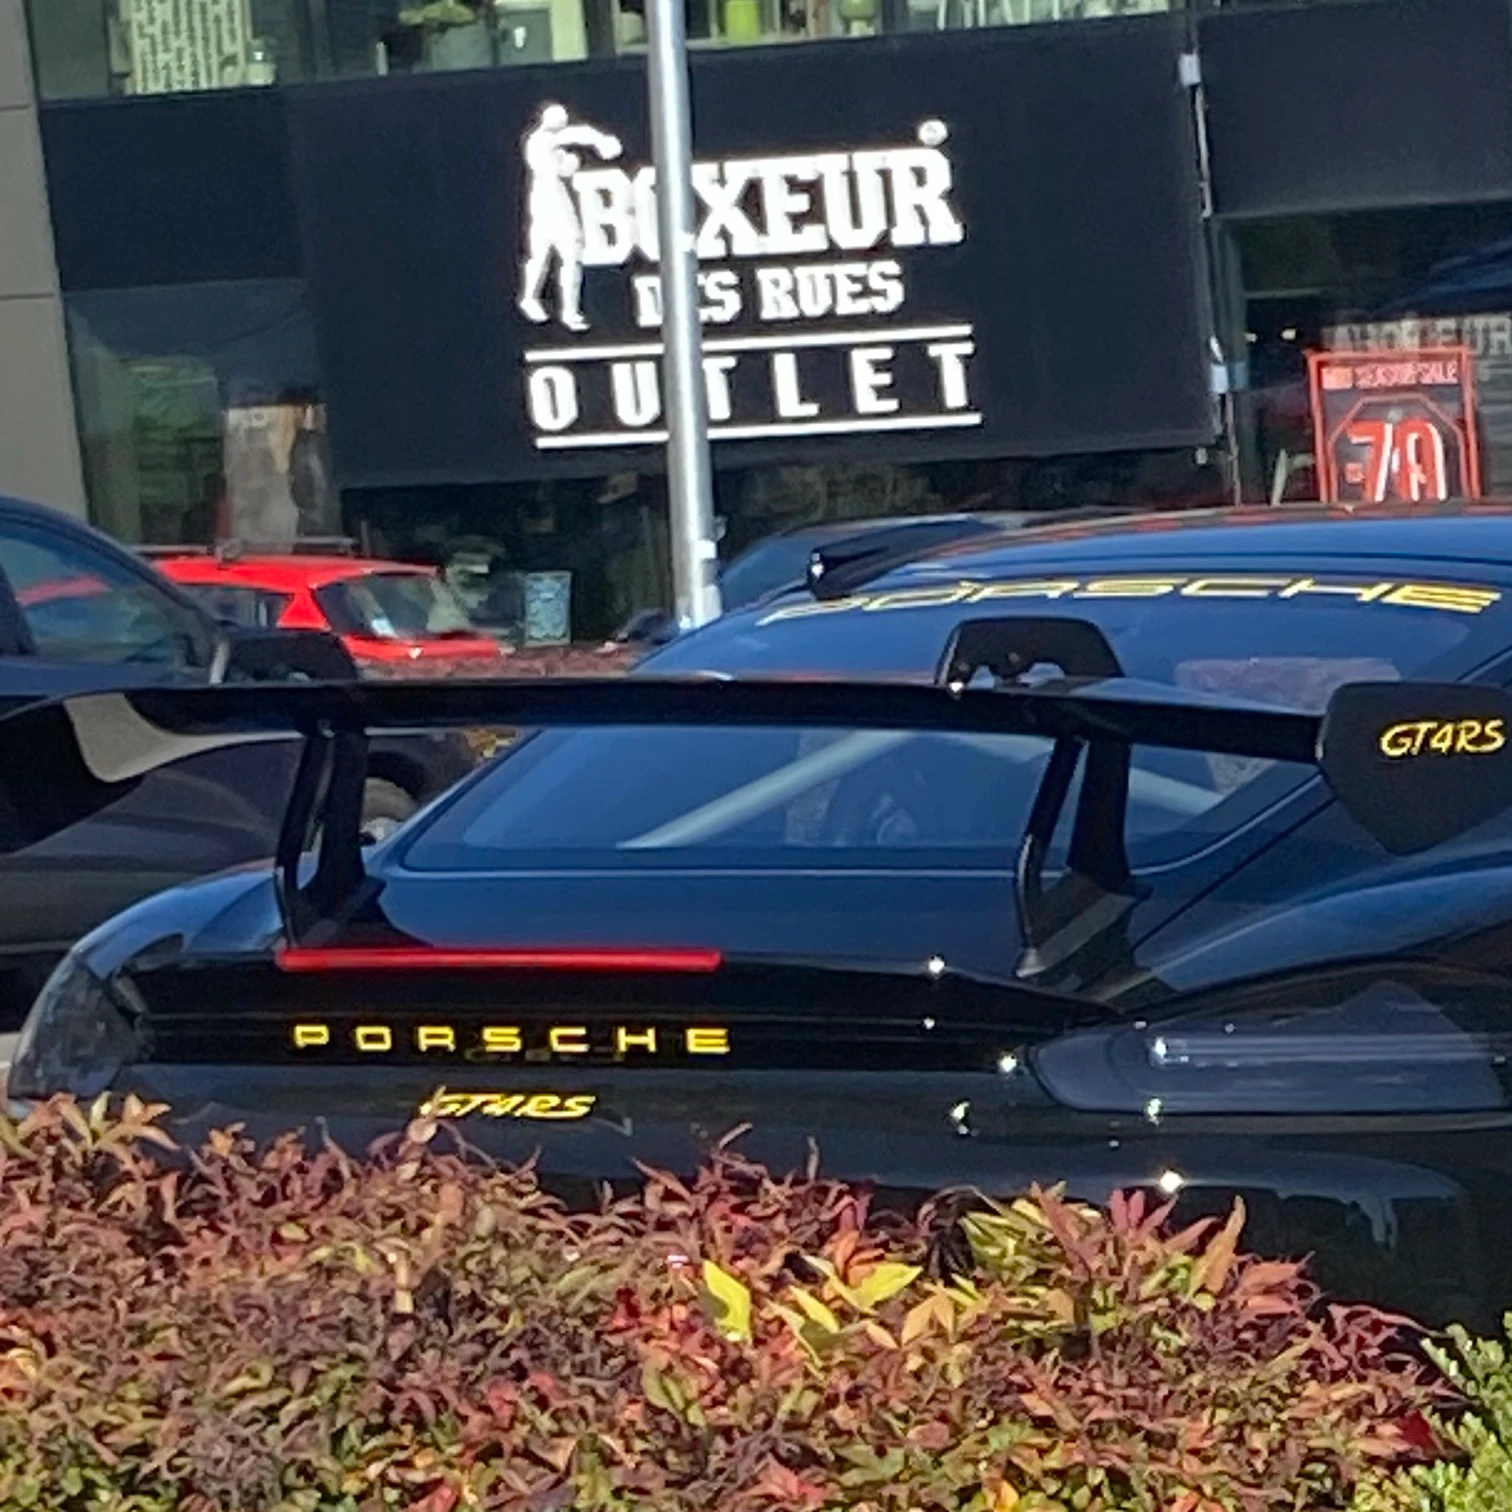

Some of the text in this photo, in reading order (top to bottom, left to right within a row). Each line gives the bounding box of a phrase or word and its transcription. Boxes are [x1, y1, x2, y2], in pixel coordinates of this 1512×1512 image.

[634, 260, 904, 328] DS RUES
[529, 342, 975, 431] OUTLET
[1380, 719, 1507, 757] GT4RS
[293, 1024, 731, 1054] PORSCHE
[419, 1093, 596, 1118] GT4RS
